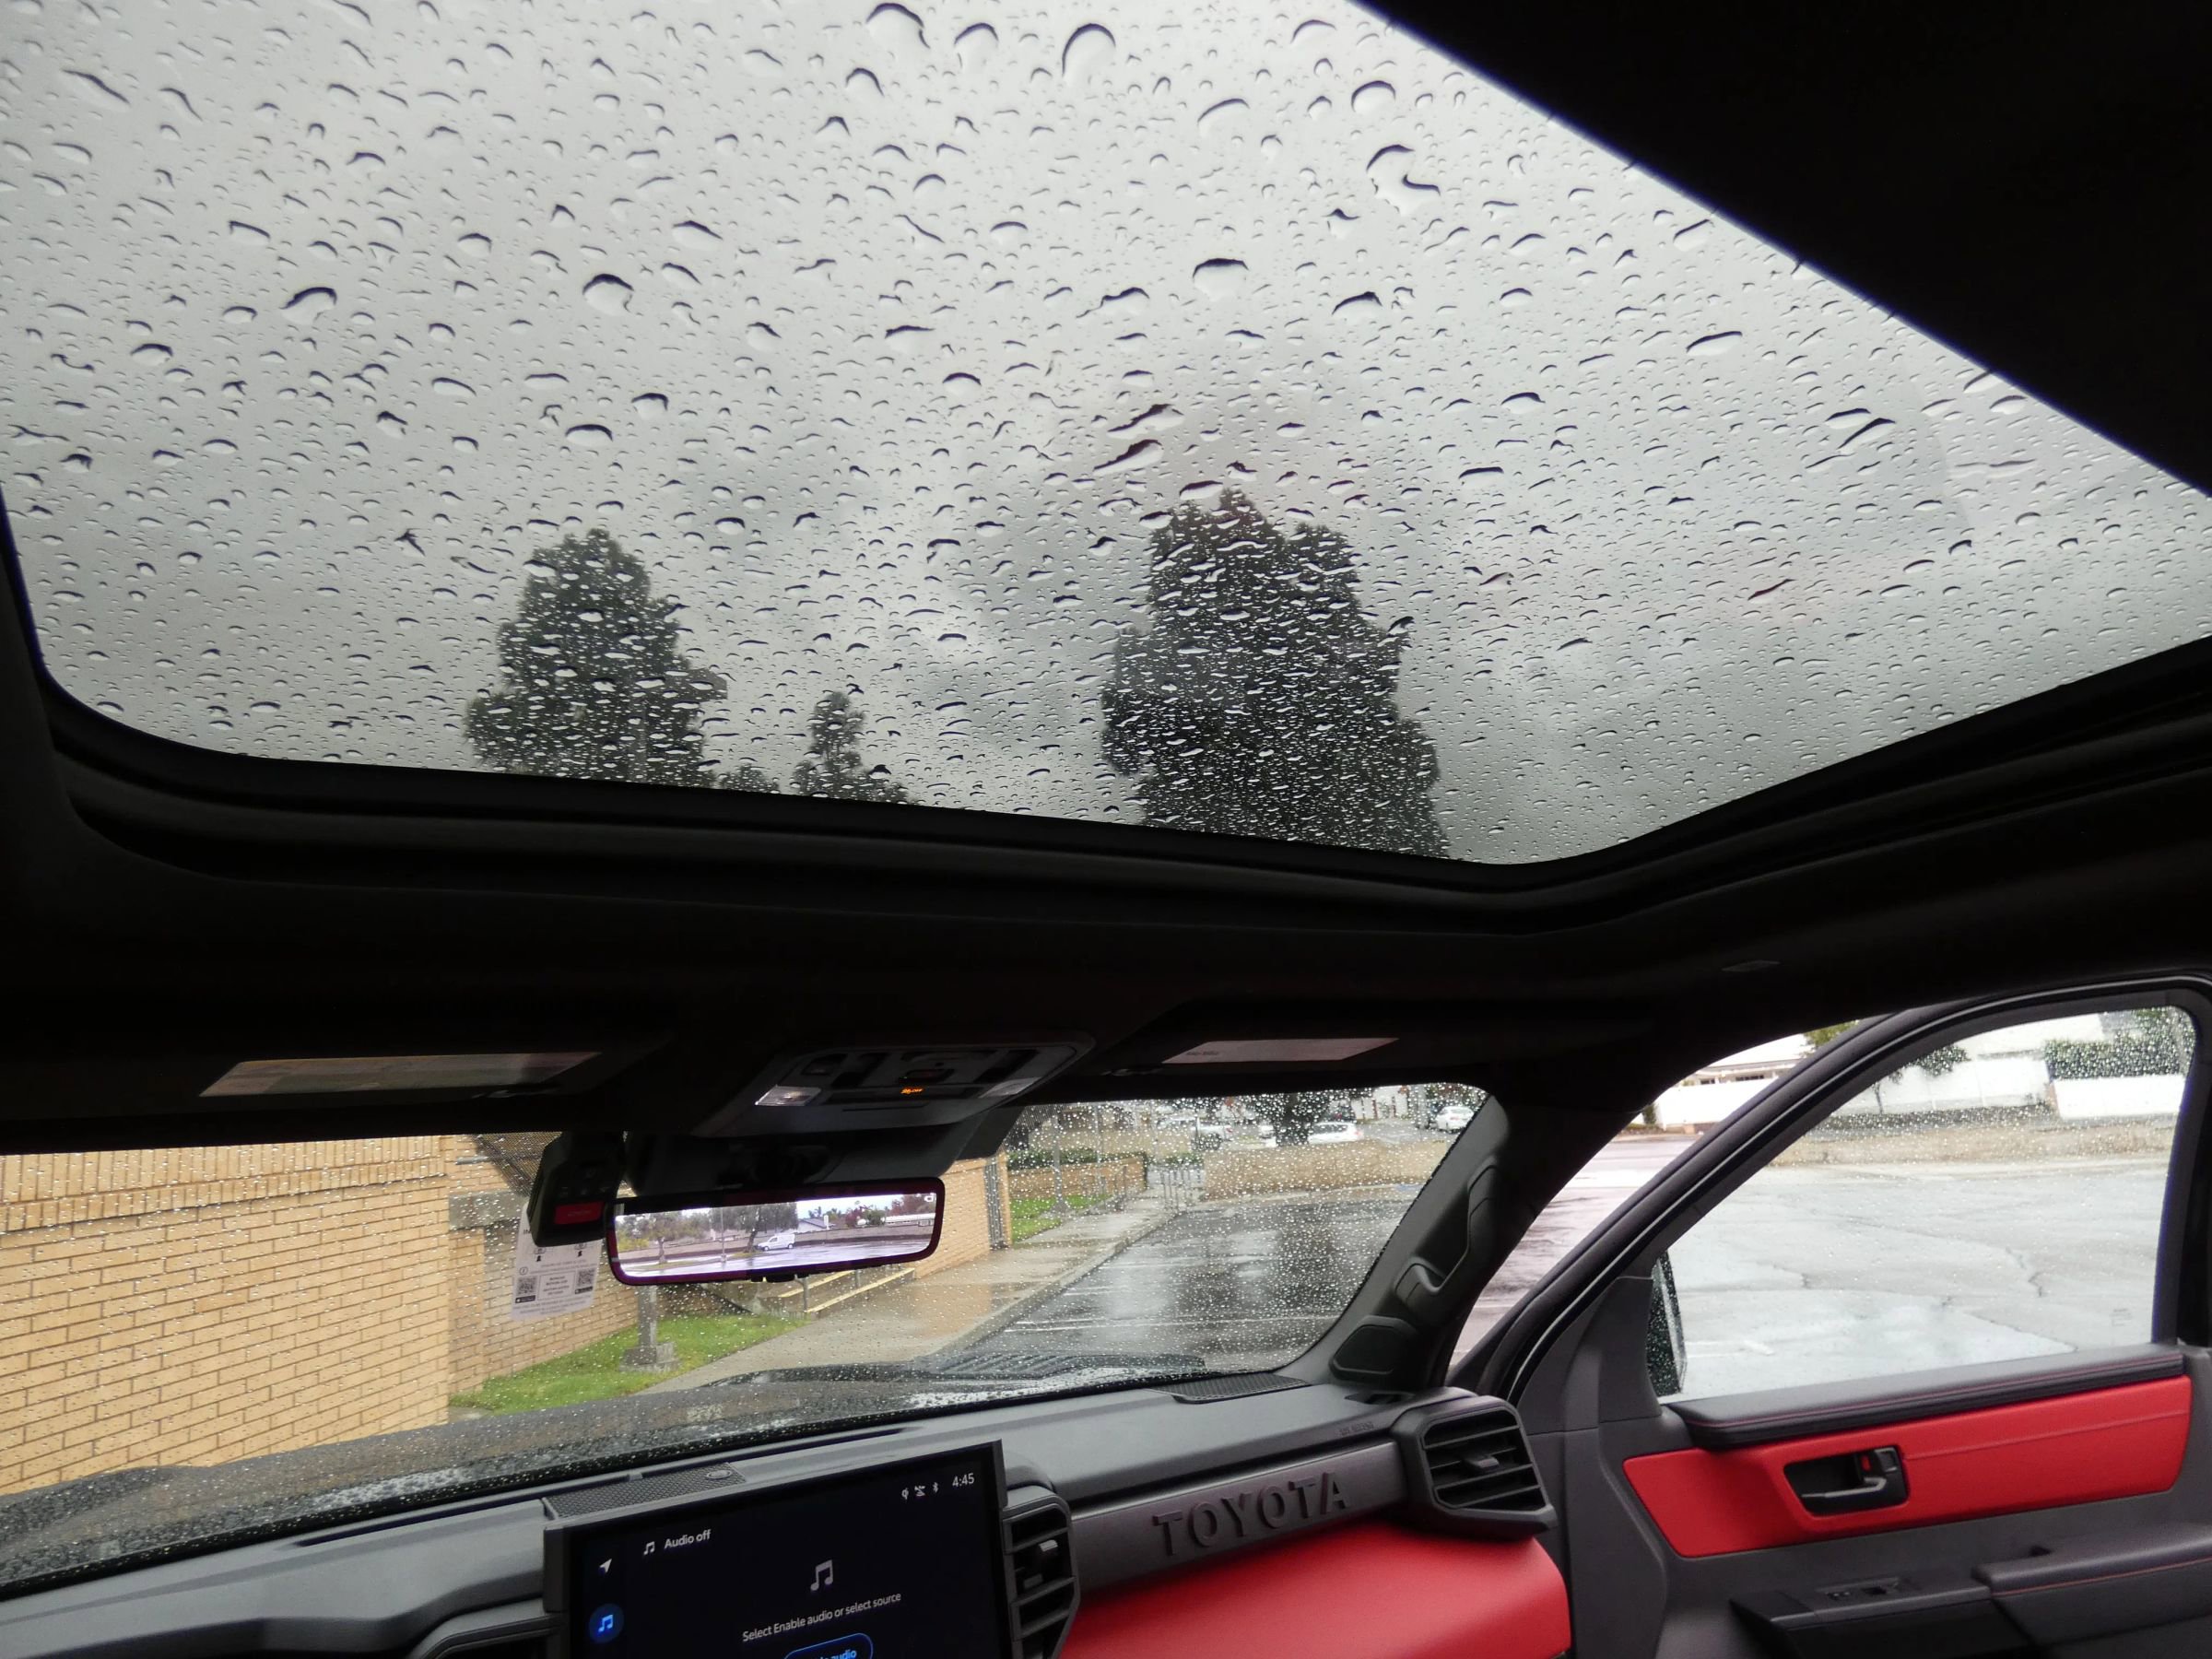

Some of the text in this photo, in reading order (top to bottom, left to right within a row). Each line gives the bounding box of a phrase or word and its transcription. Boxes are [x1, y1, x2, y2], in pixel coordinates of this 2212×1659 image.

[952, 1473, 974, 1488] 4:45
[1152, 1472, 1347, 1557] TOYOTA
[664, 1529, 712, 1548] Audio off
[743, 1594, 901, 1641] Select Enable audio or select source
